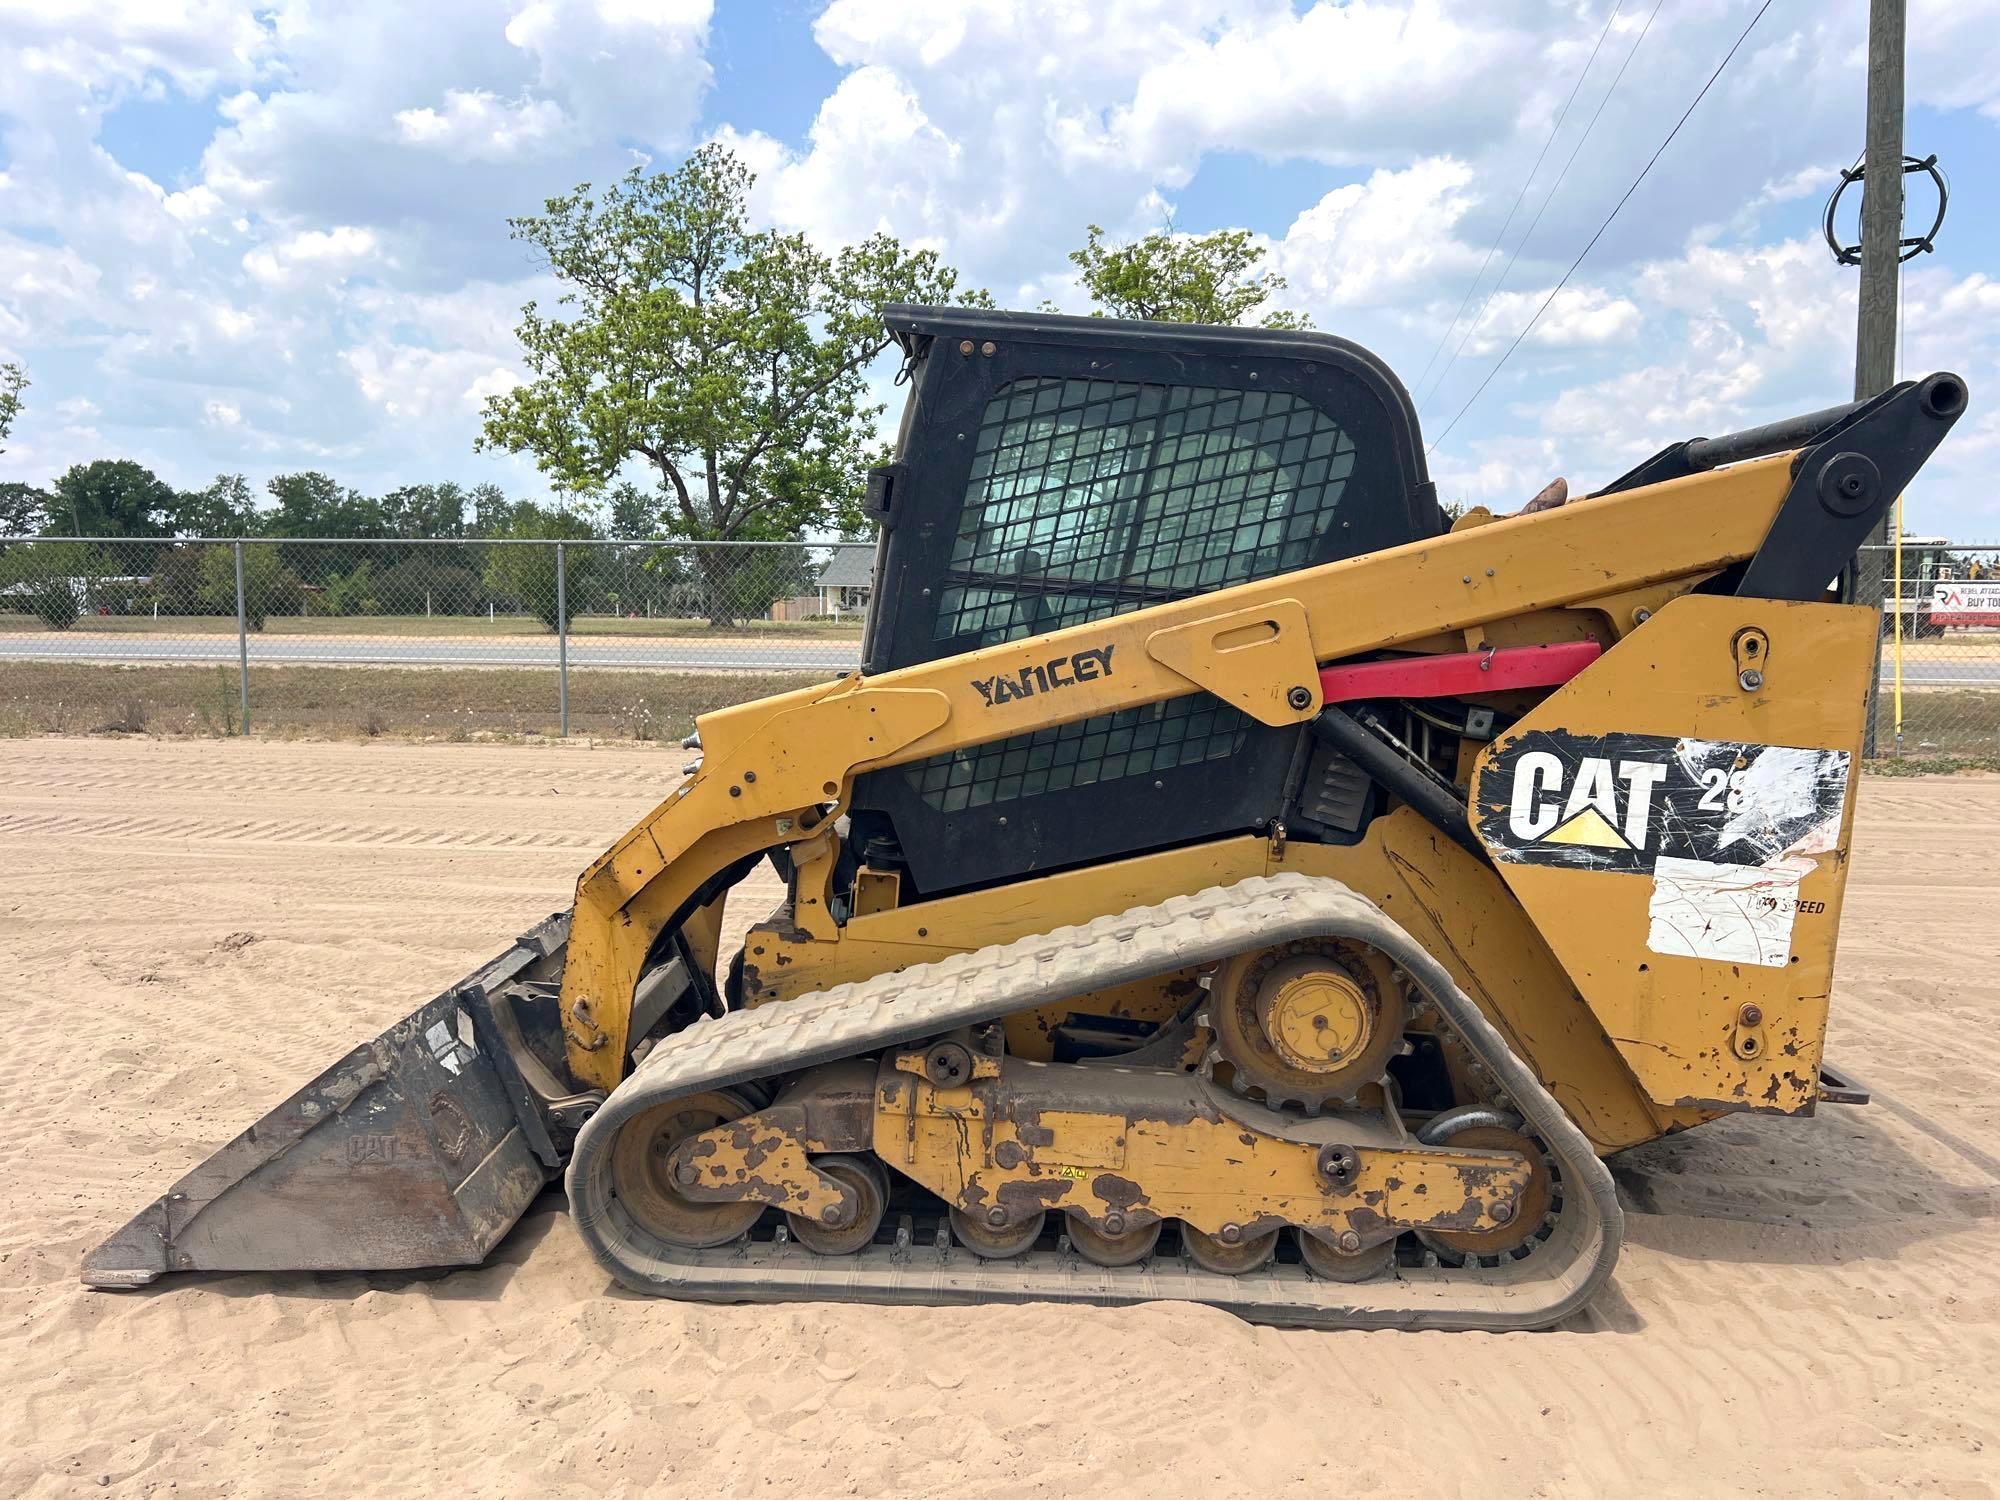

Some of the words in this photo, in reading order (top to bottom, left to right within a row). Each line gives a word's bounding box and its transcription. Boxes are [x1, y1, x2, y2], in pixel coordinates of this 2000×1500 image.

[1967, 597, 1985, 607] BUY
[970, 644, 1115, 707] YANCEY
[1509, 751, 1668, 851] CAT
[350, 1135, 396, 1162] CAT
